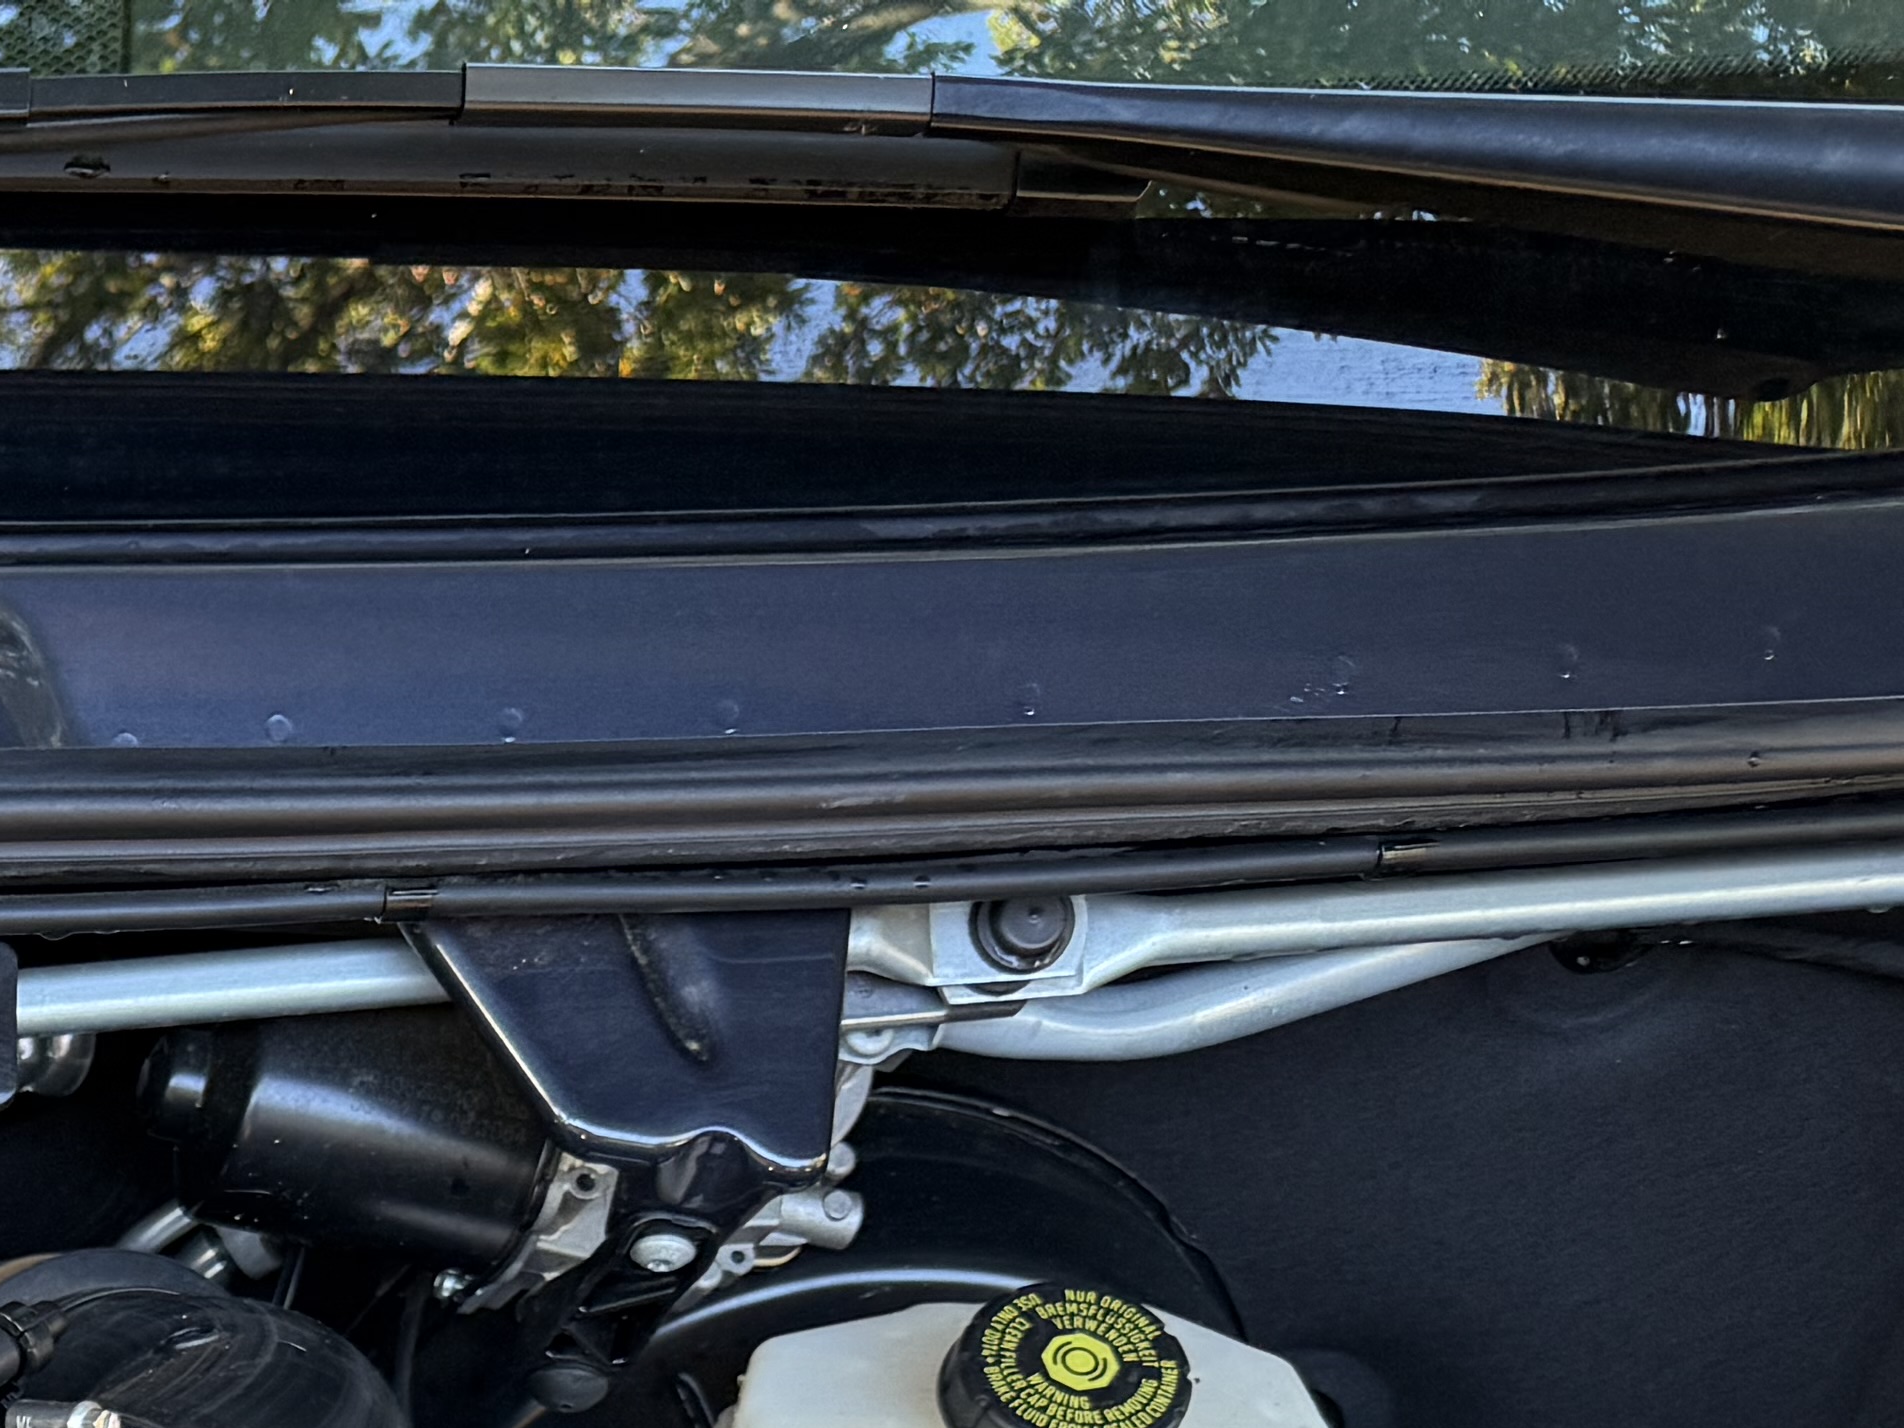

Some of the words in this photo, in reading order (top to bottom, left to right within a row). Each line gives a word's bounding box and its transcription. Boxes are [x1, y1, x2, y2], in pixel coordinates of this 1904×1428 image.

[990, 1306, 1019, 1331] ONLY
[1064, 1289, 1096, 1304] NUR
[1100, 1296, 1163, 1341] ORIGINAL
[1051, 1315, 1140, 1363] VERWENDEN
[983, 1365, 1017, 1402] BRAKE
[1000, 1351, 1027, 1390] FILLER
[1020, 1387, 1045, 1408] CAP
[1045, 1404, 1103, 1424] BEFORE
[1103, 1378, 1159, 1420] REMOVING
[1026, 1372, 1090, 1409] WARNING
[1145, 1360, 1179, 1418] CONTAINER
[1009, 1398, 1046, 1428] FLUID
